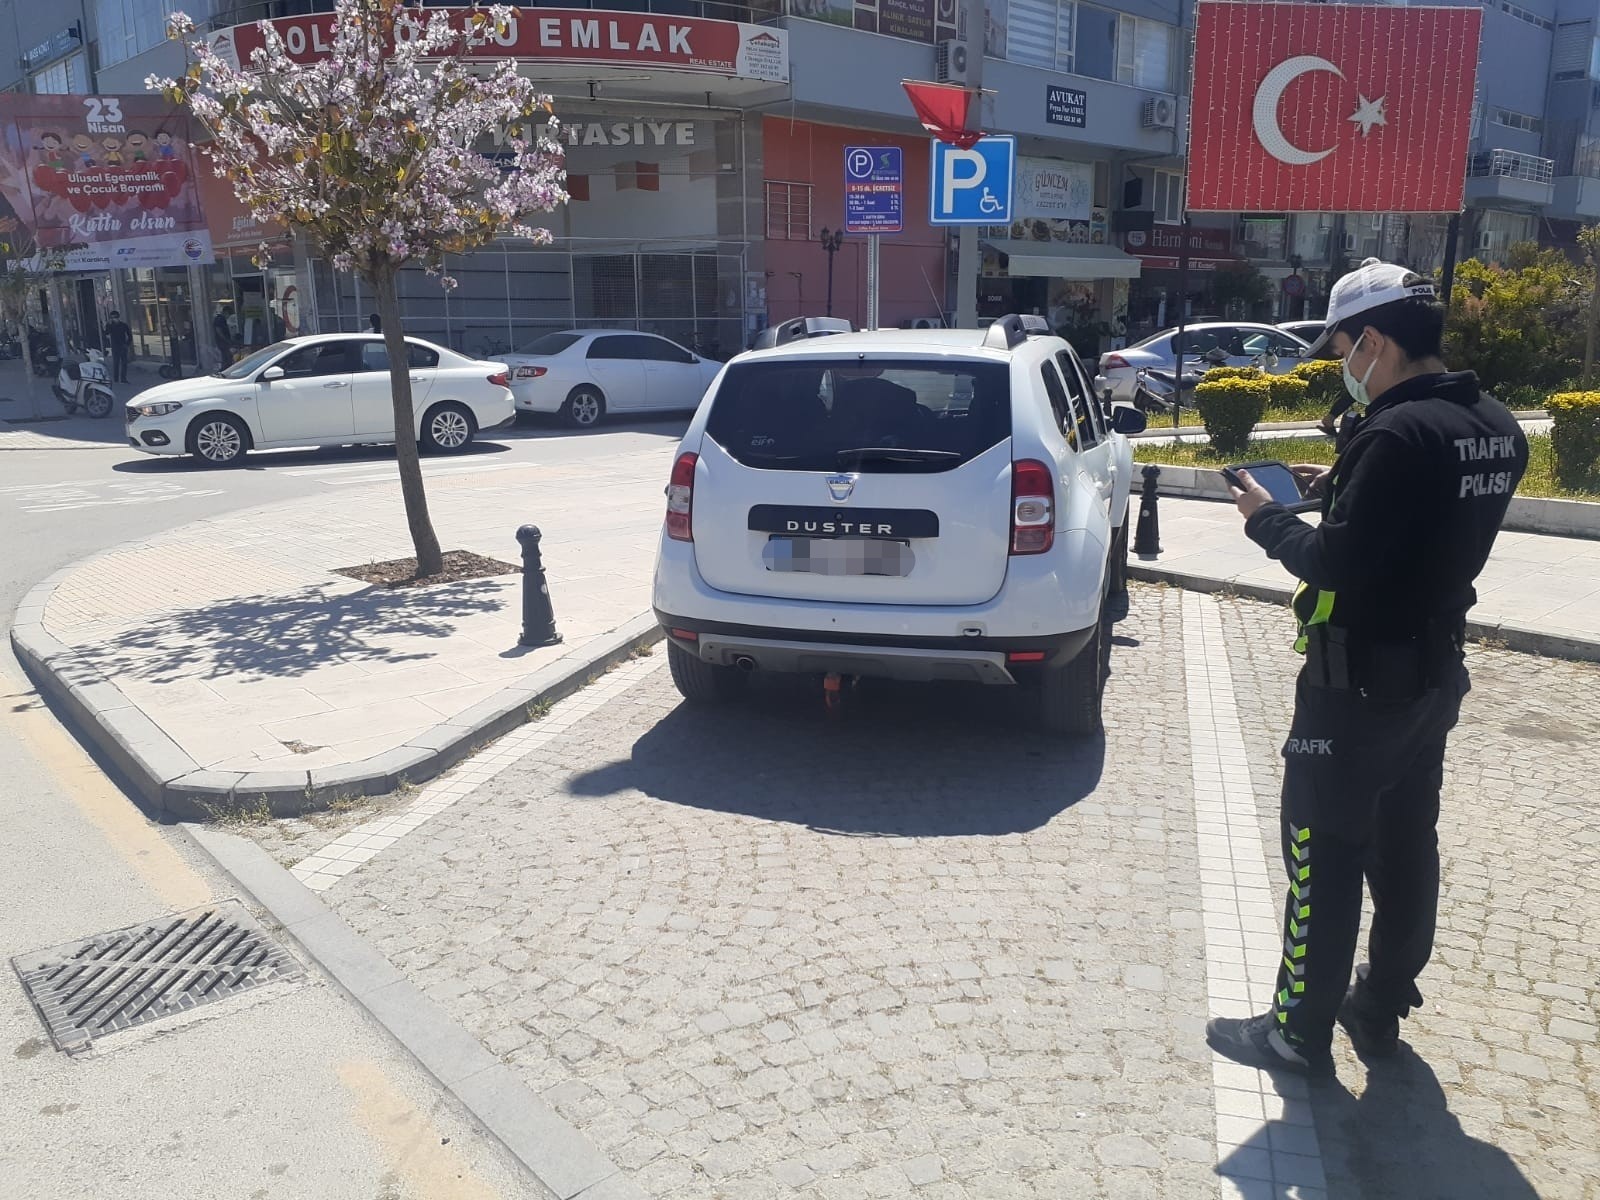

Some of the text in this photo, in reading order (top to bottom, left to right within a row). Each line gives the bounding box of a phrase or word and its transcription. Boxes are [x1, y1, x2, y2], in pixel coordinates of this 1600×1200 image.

[540, 18, 693, 55] EMLAK
[689, 57, 707, 66] REAL
[708, 59, 733, 69] ESTATE
[1049, 90, 1085, 106] AVUKAT
[83, 98, 123, 123] 23
[87, 122, 126, 134] Nisan
[494, 116, 695, 146] KIRTASİYE
[855, 154, 868, 173] P
[68, 171, 160, 185] Ulusal Egemenlik
[943, 149, 987, 213] P
[67, 181, 165, 195] ve Çocuk Bayramı
[68, 210, 176, 238] Kutlu olsun
[1152, 229, 1202, 249] Harmni
[1453, 435, 1517, 462] TRAFİK
[1458, 471, 1512, 498] POLİSİ
[786, 520, 893, 535] DUSTER
[1286, 737, 1333, 755] TRAFİK
